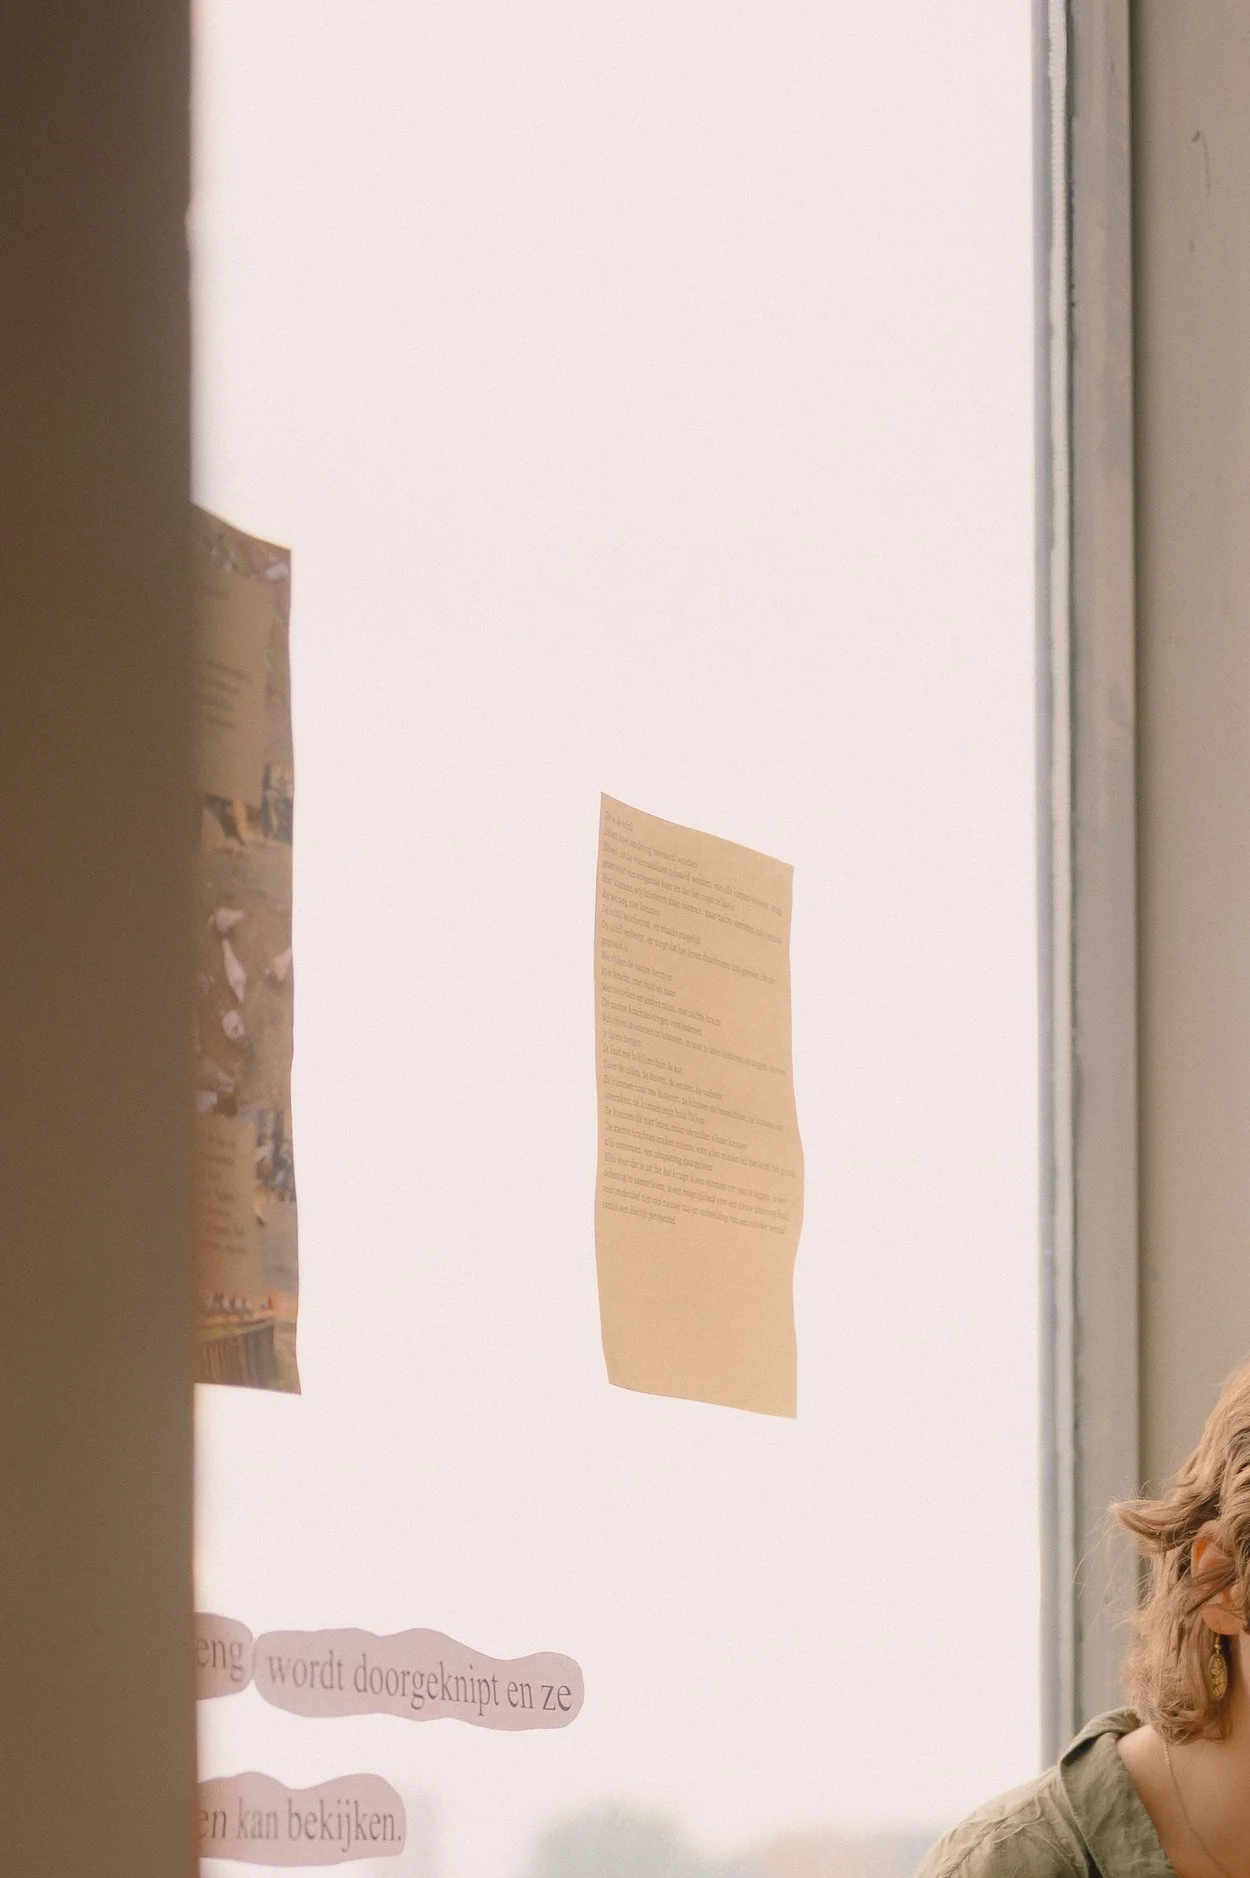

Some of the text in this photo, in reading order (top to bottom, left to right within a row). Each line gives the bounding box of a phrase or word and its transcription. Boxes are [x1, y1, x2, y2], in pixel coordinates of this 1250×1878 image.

[266, 1651, 345, 1691] wordt
[352, 1653, 500, 1717] doorgeknipt
[507, 1681, 535, 1711] en
[540, 1682, 574, 1712] ze
[237, 1796, 279, 1839] kan
[286, 1798, 403, 1853] bekijken.
